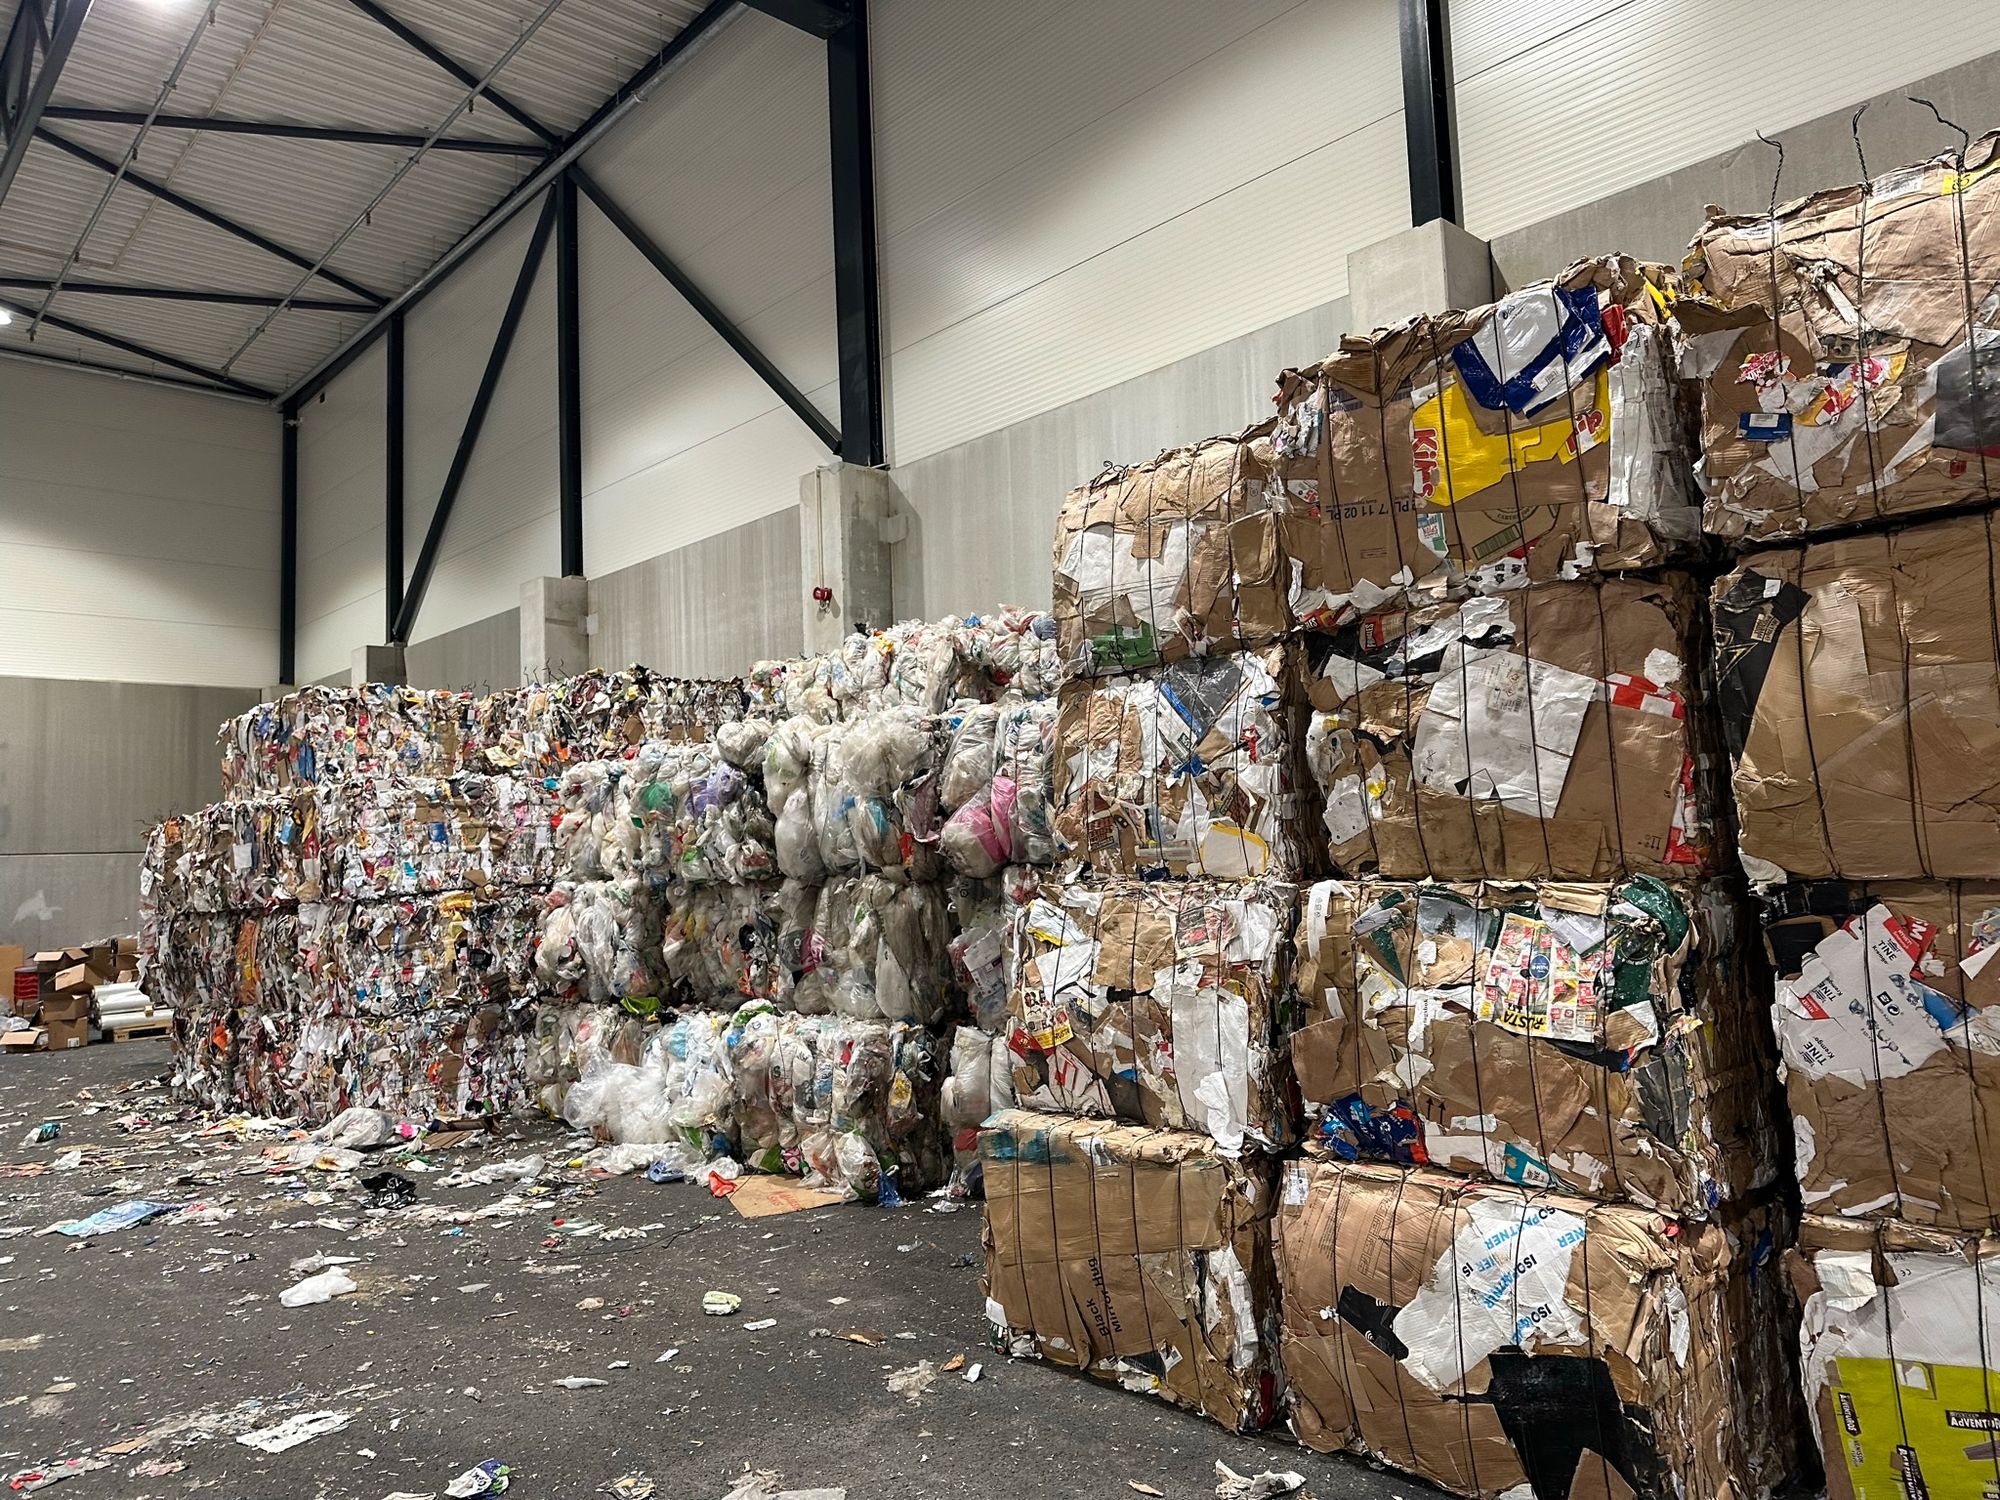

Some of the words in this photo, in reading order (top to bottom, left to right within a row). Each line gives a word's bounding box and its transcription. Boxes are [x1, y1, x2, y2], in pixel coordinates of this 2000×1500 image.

[1344, 507, 1358, 518] 02
[1362, 506, 1375, 516] 11
[1395, 501, 1409, 512] PL
[1877, 940, 1898, 962] TINE
[1818, 981, 1838, 1002] TINE
[1804, 1041, 1828, 1066] TINE
[1088, 1257, 1104, 1287] Hug
[1086, 1298, 1111, 1337] Black
[1101, 1289, 1123, 1333] Mirror
